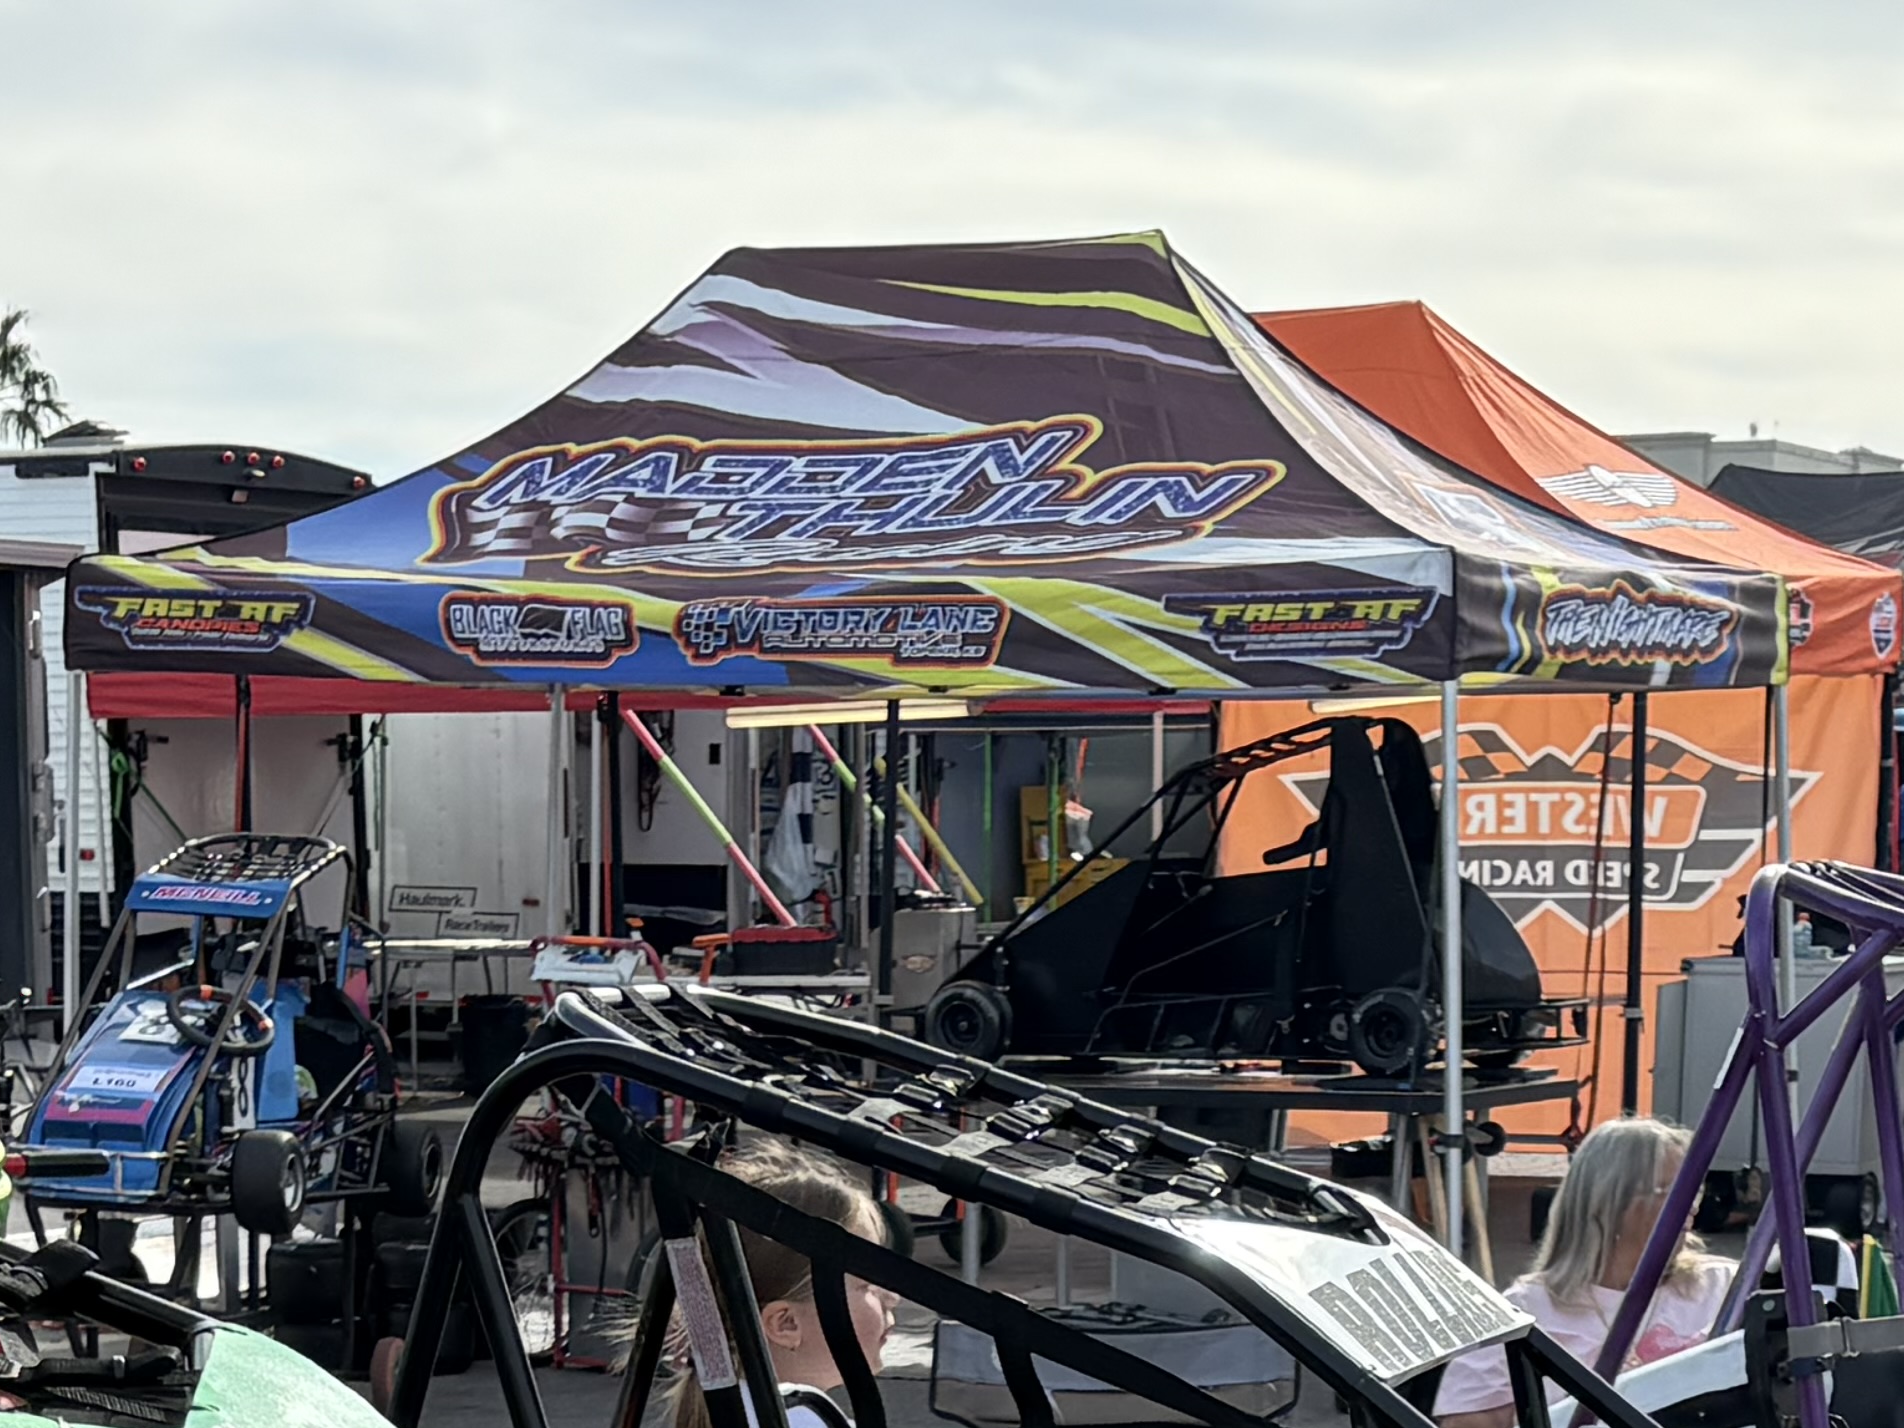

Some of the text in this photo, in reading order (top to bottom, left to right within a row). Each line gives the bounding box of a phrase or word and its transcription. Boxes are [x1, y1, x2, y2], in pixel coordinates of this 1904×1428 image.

[106, 596, 222, 618] FAST
[451, 603, 623, 640] BLACK FLAG
[1201, 605, 1344, 624] FAST
[731, 601, 1000, 643] VICTORY LANE
